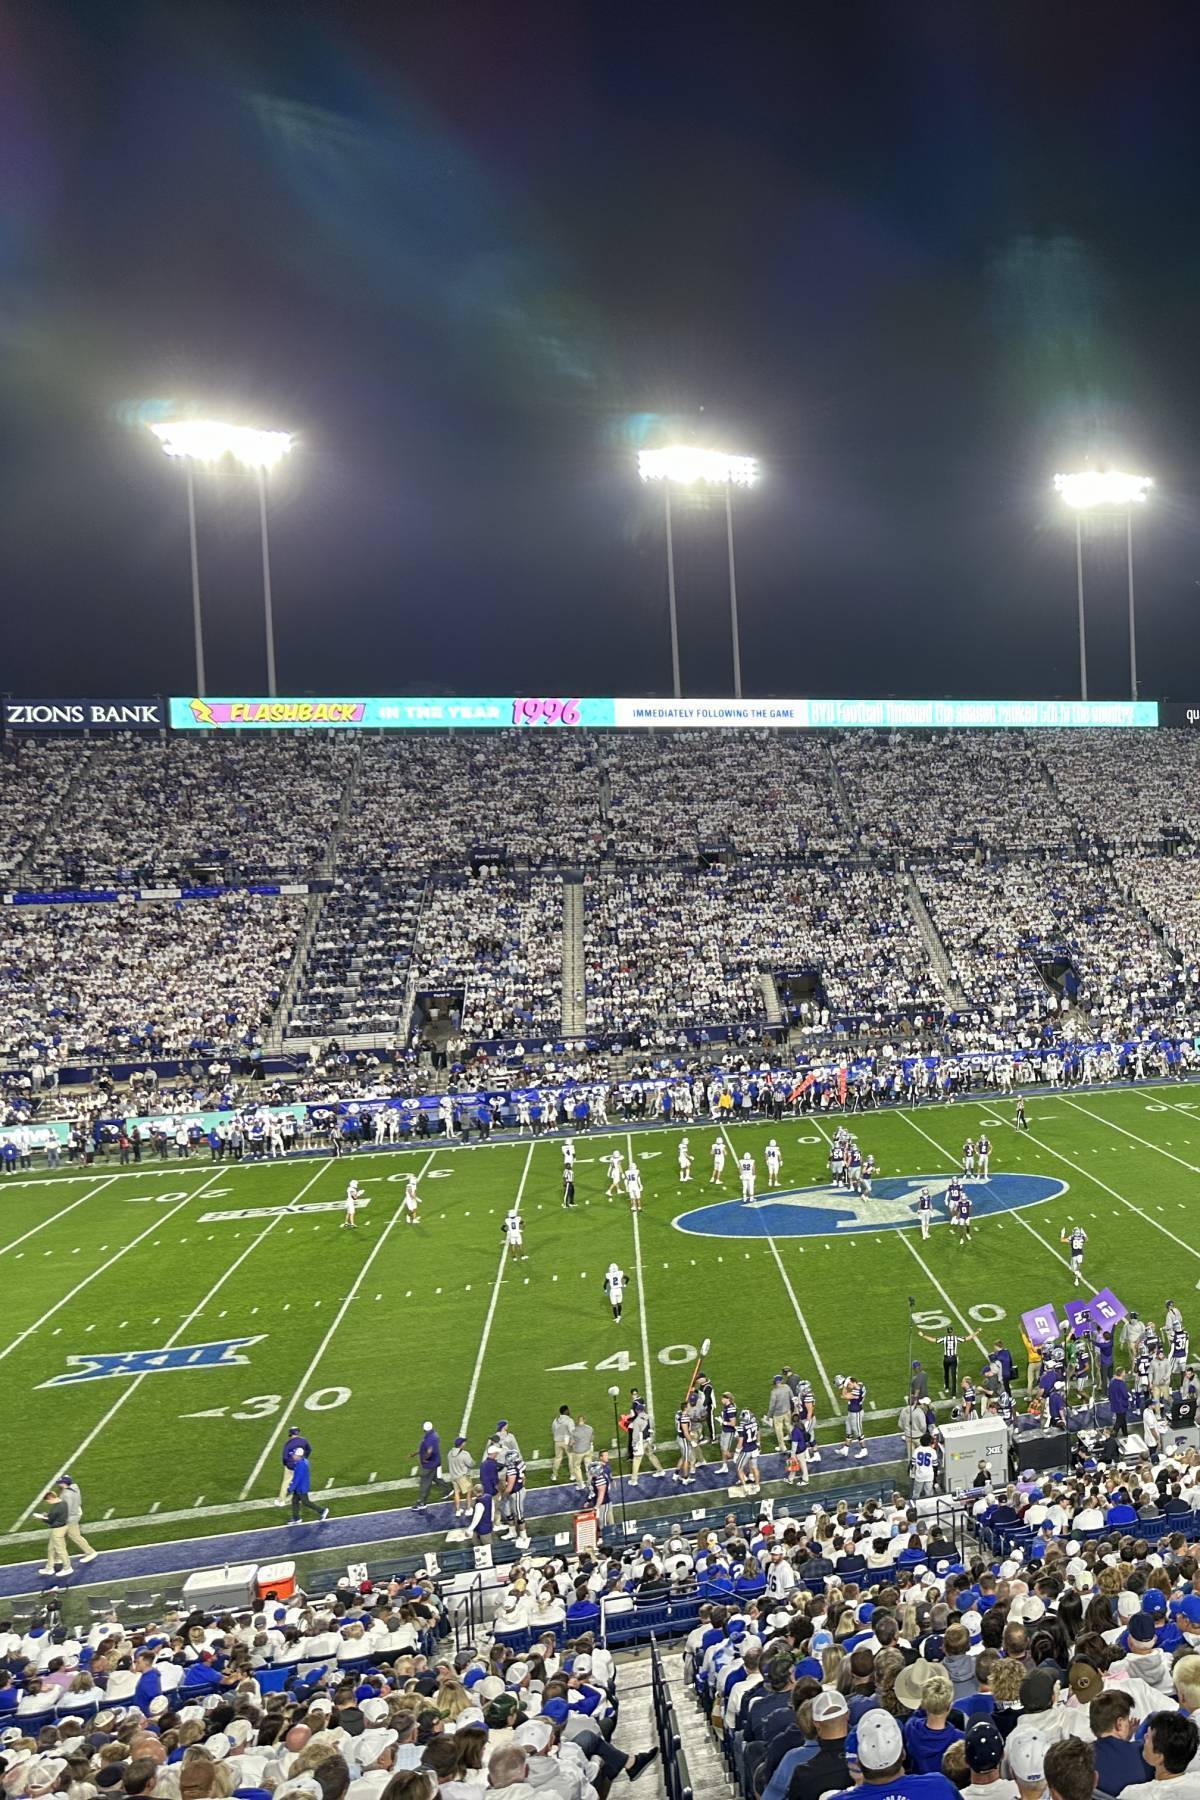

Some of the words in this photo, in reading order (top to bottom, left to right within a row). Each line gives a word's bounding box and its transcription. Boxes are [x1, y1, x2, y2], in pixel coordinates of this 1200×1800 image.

[7, 705, 84, 723] ZIONS
[91, 705, 160, 723] BANK
[230, 703, 358, 722] FLASHBACK
[406, 708, 444, 719] THE
[448, 708, 500, 719] YEAR
[511, 698, 580, 725] 1996
[632, 709, 694, 719] IMMEDIATELY
[696, 709, 748, 718] FOLLOWING
[750, 709, 767, 718] THE
[769, 709, 795, 718] GAME
[740, 1176, 992, 1230] Y
[612, 1277, 618, 1286] 2
[911, 1303, 1007, 1330] 50
[595, 1344, 698, 1371] 40
[231, 1386, 352, 1420] 30
[916, 1451, 932, 1467] 96
